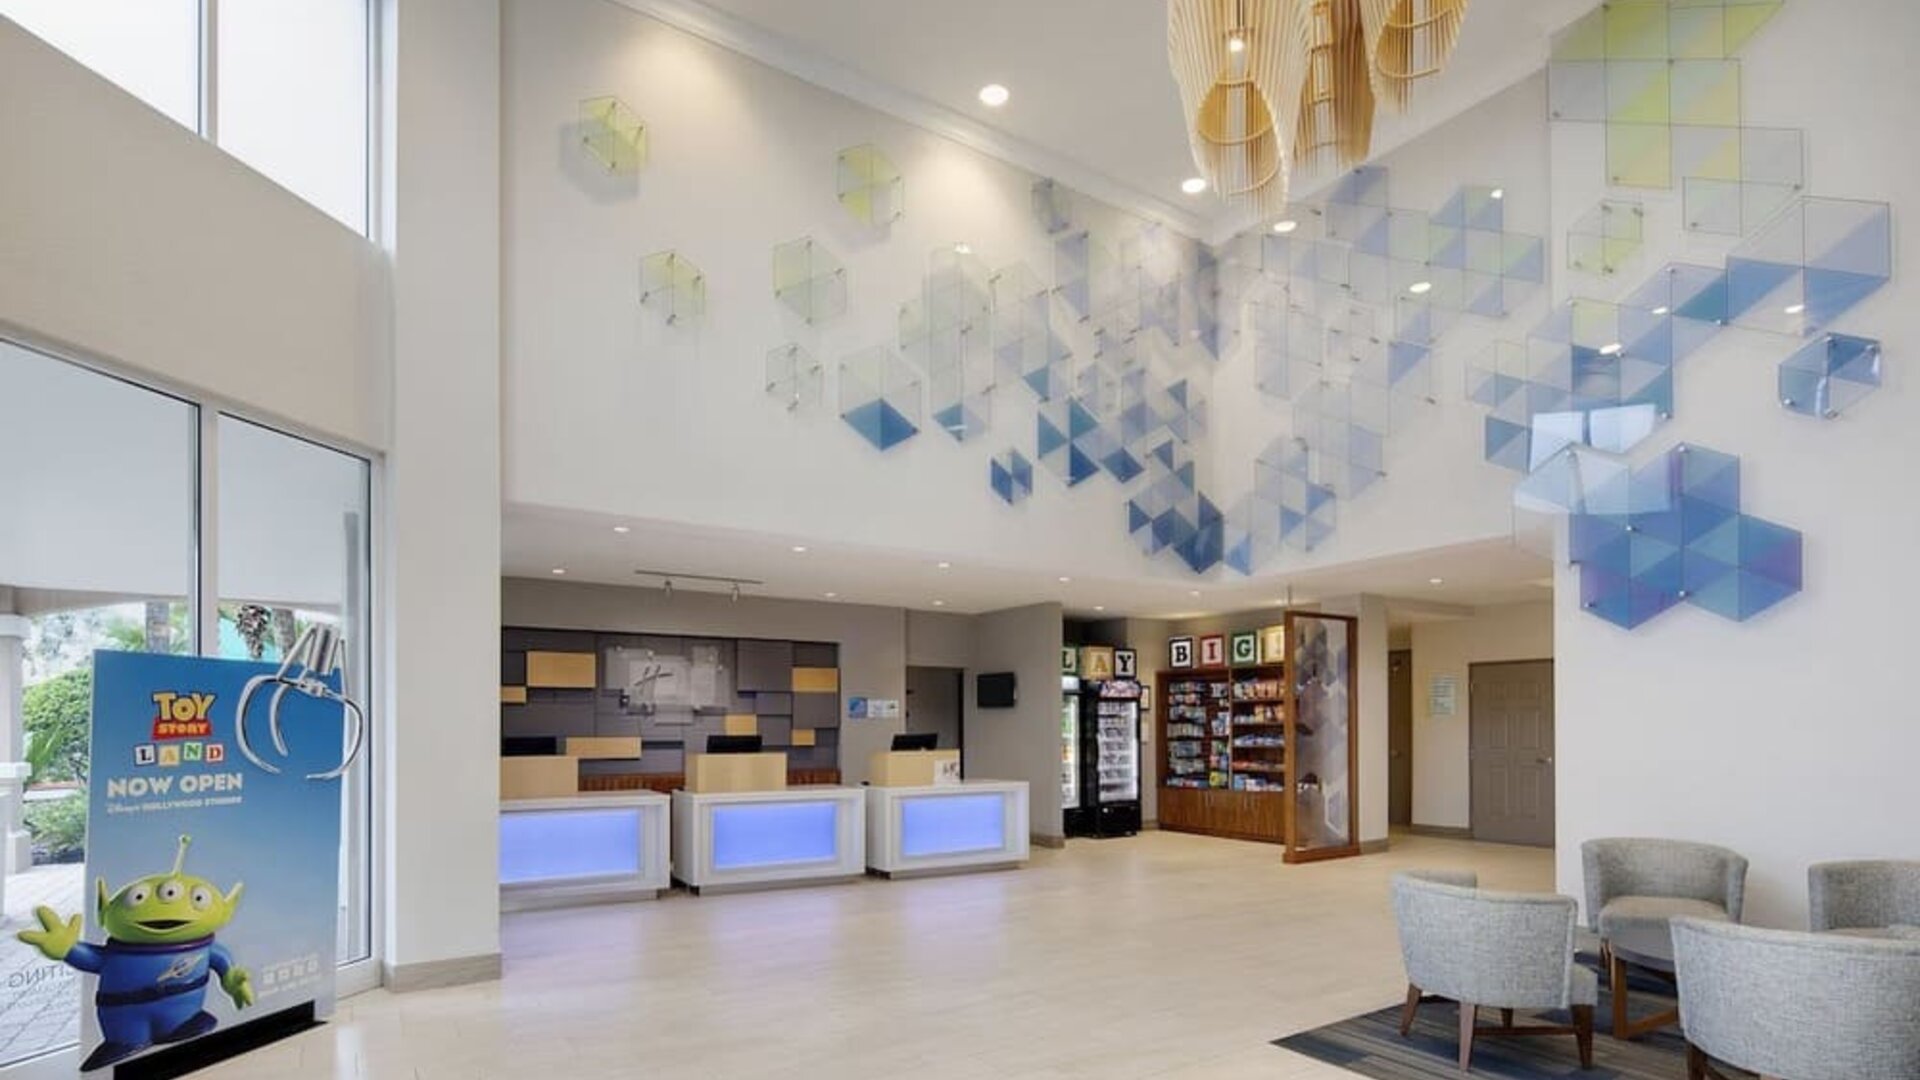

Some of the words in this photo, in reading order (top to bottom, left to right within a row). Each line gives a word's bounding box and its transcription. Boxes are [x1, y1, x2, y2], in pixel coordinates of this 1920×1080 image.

[152, 692, 216, 721] TOY
[157, 722, 209, 735] STORY
[137, 743, 220, 764] LAND
[106, 776, 174, 799] NOW
[179, 773, 242, 793] OPEN
